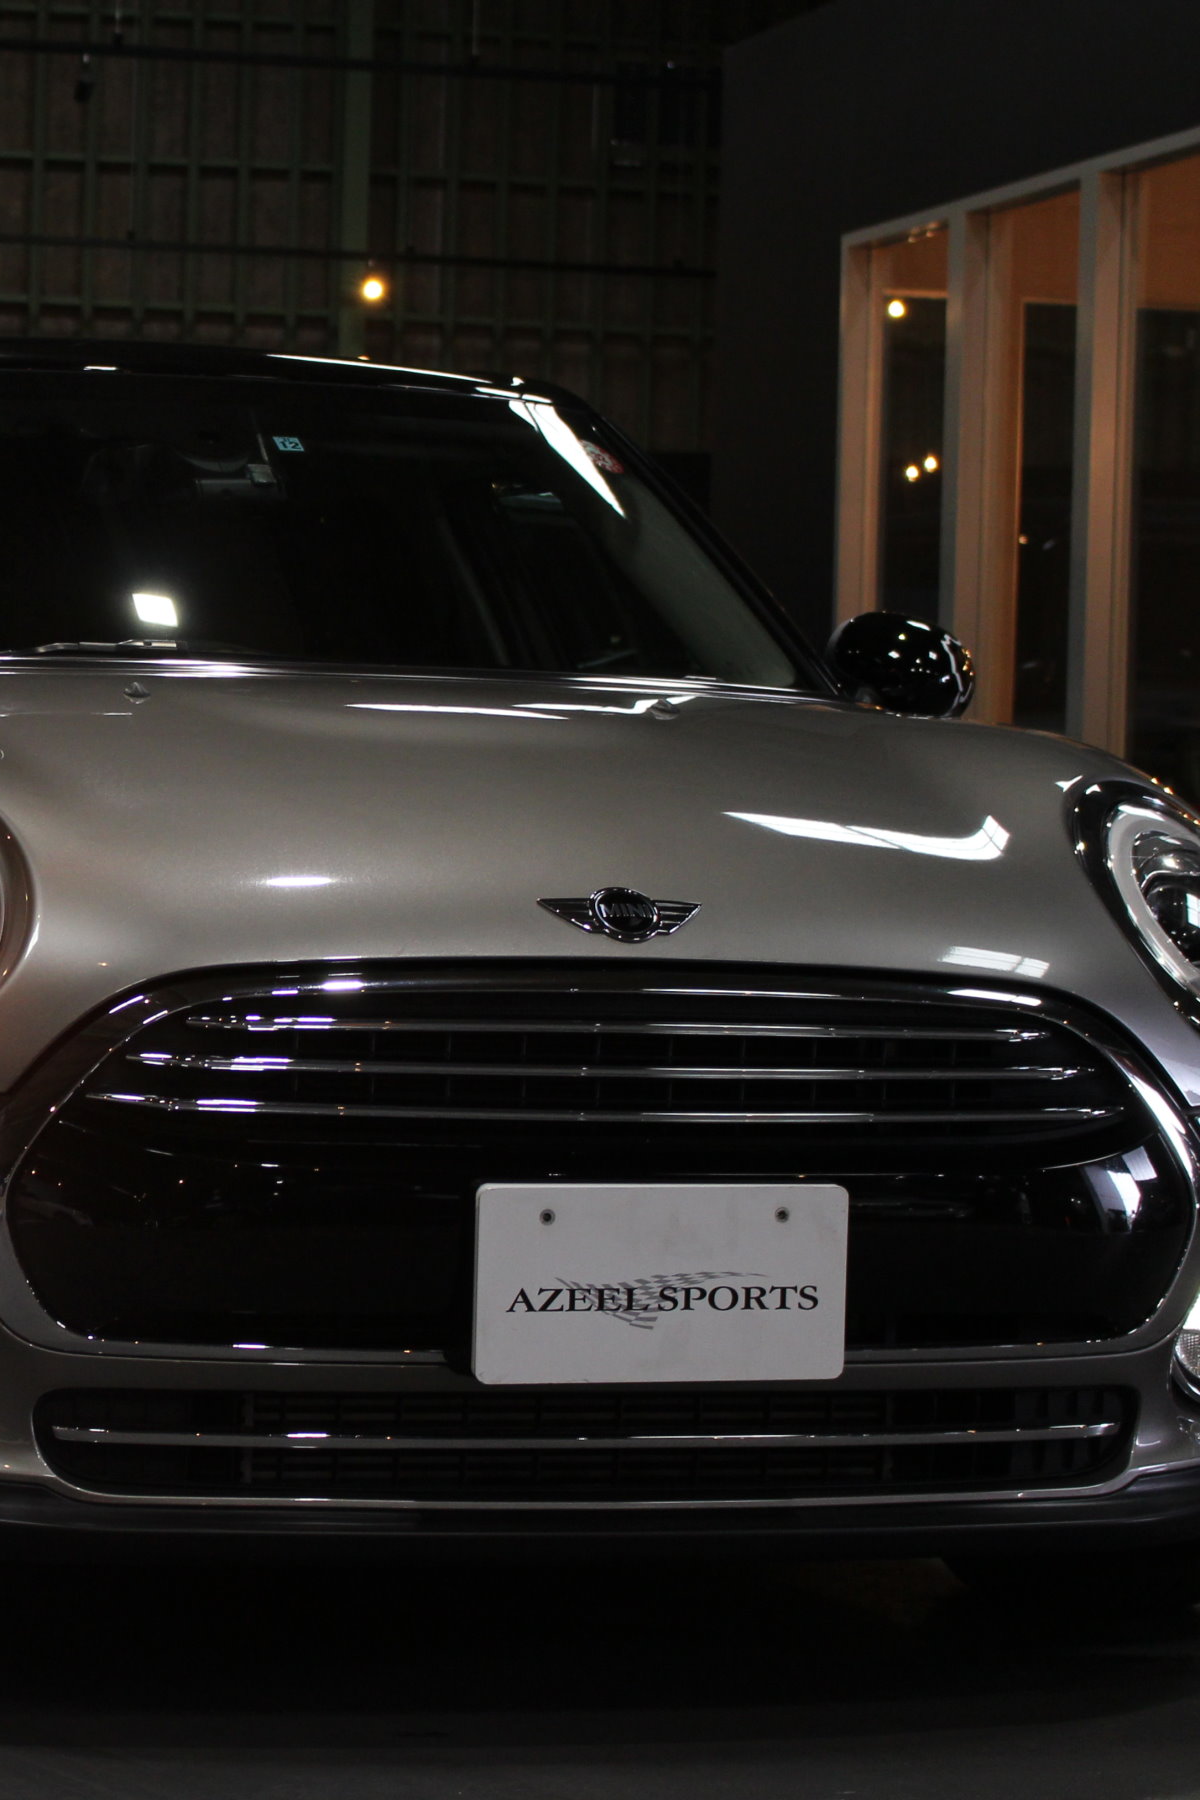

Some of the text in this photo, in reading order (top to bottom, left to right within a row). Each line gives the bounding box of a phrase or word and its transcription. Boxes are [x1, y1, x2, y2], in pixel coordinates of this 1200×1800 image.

[599, 903, 653, 918] MINI
[506, 1285, 819, 1312] AZEEL SPORTS
